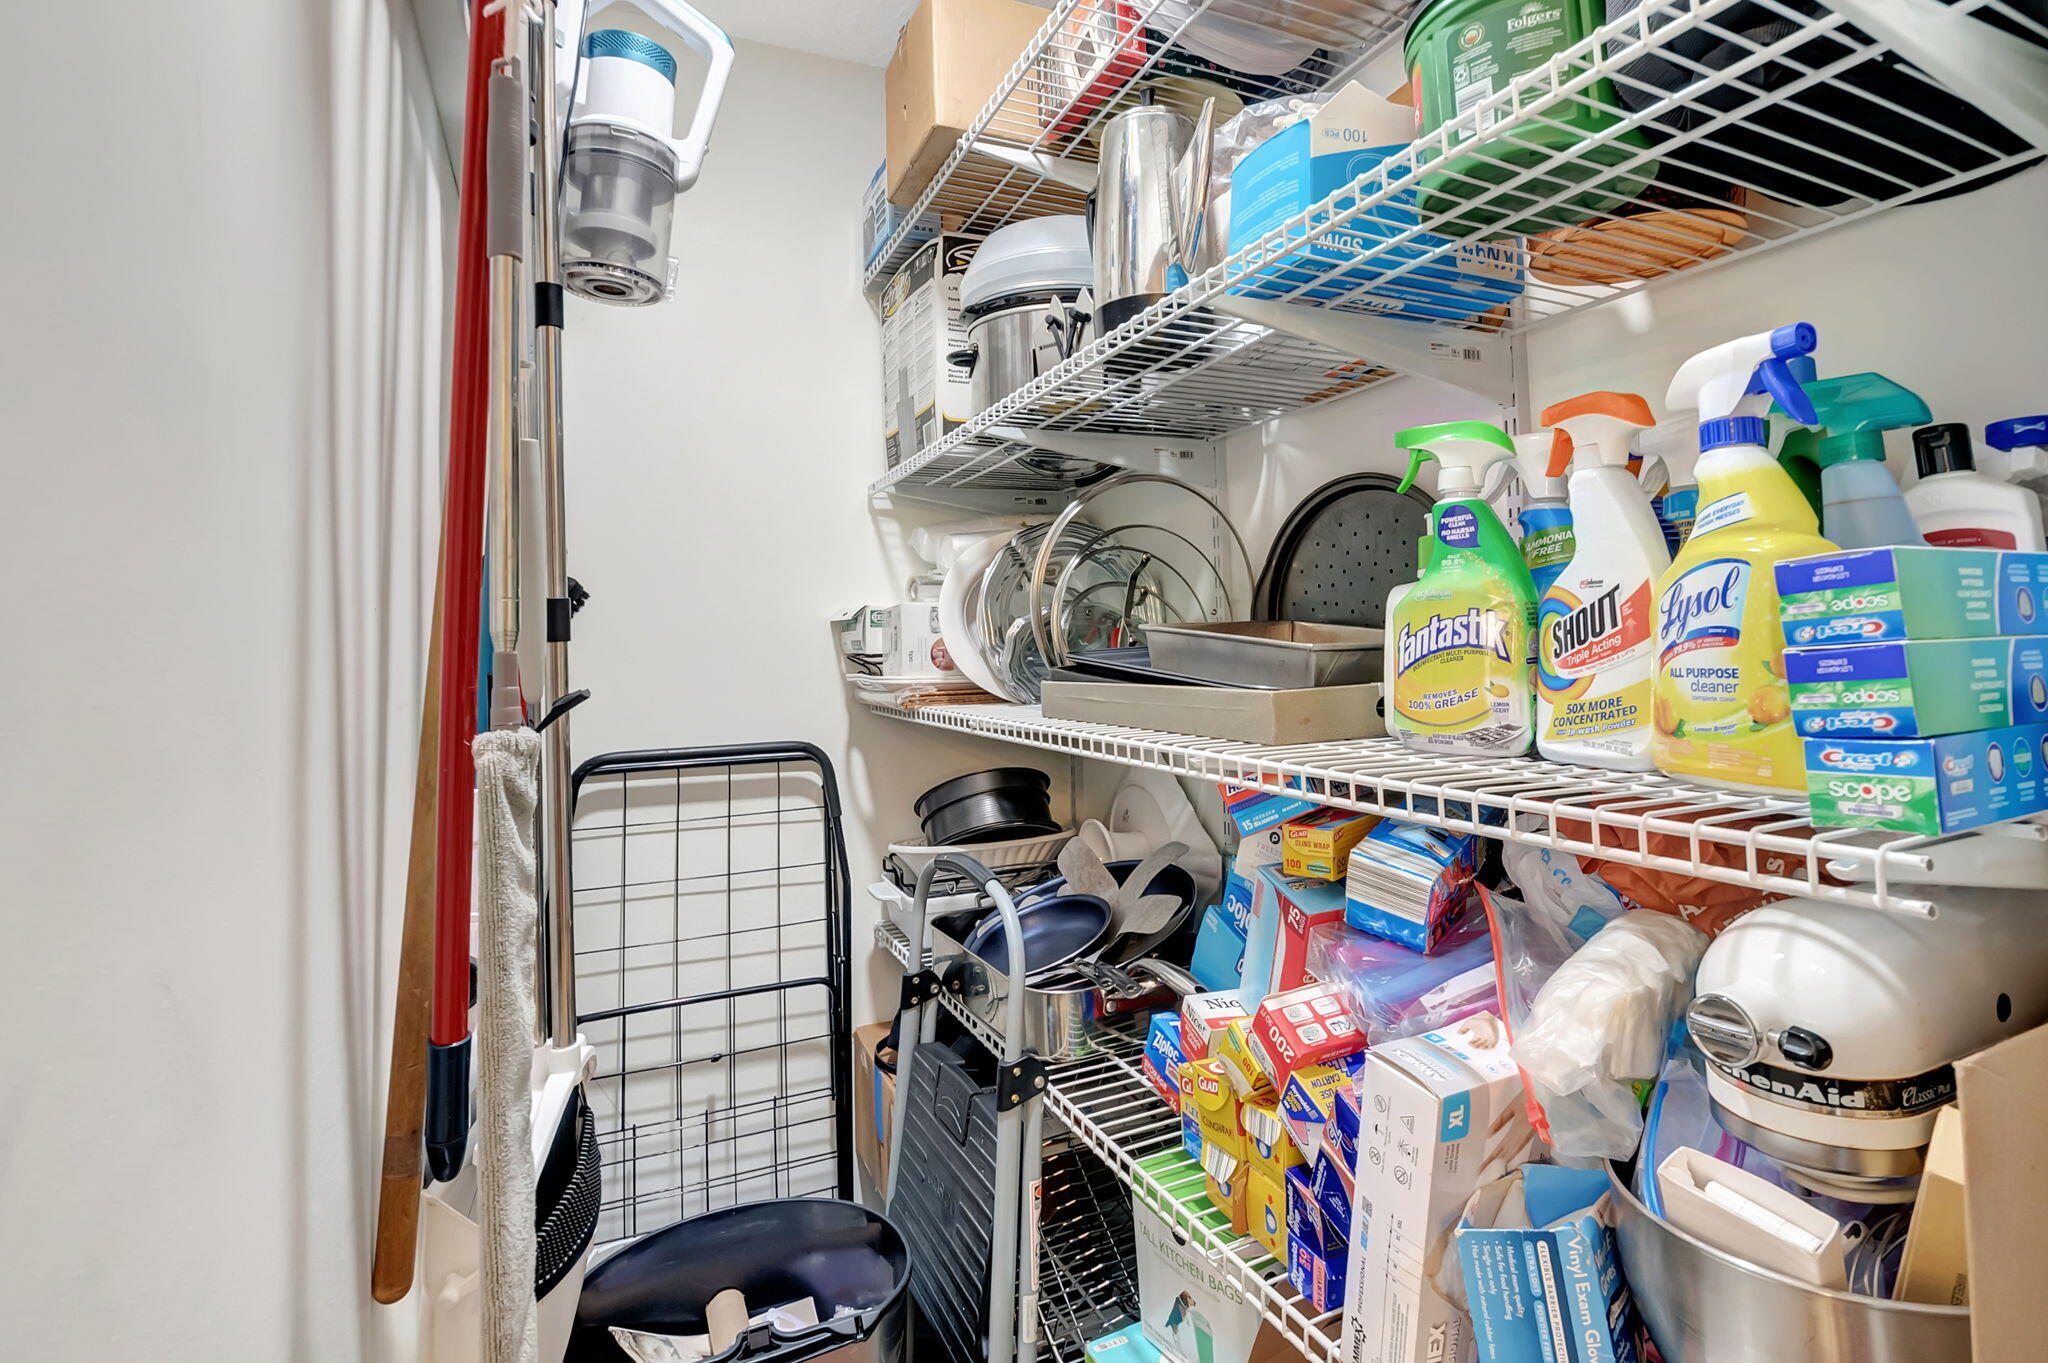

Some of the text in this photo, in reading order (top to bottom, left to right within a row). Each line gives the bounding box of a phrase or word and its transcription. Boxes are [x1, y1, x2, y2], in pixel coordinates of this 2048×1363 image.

[1507, 8, 1562, 33] Folgers
[1343, 128, 1368, 143] 100
[1440, 514, 1474, 525] POWERFUL
[1441, 526, 1475, 537] NO HARSH
[1446, 533, 1470, 541] SMELLS
[1525, 530, 1573, 552] AMMONIA
[1532, 542, 1563, 558] FREE
[1660, 565, 1740, 640] Lysol
[1830, 594, 1889, 611] scope
[1553, 583, 1620, 659] SHOUT
[1816, 620, 1885, 640] Crest
[1398, 608, 1512, 679] fantastik
[1567, 649, 1590, 667] Triple
[1591, 634, 1622, 654] Acting
[1440, 656, 1464, 665] CLEANER
[1670, 667, 1739, 679] ALL PURPOSE
[1423, 688, 1458, 700] REMOVES
[1690, 681, 1739, 693] cleaner
[1841, 688, 1900, 704] scope
[1408, 687, 1479, 711] 100% GREASE
[1566, 696, 1623, 715] 50X MORE
[1553, 705, 1638, 728] CONCENTRATED
[1602, 718, 1637, 732] Powder
[1826, 716, 1896, 732] Crest
[1820, 749, 1894, 765] Crest
[1828, 780, 1913, 805] scope
[1241, 819, 1254, 831] 15
[1290, 830, 1308, 838] GLAD
[1295, 840, 1330, 850] CLING WRAP
[1286, 859, 1302, 869] 100
[1287, 906, 1301, 931] 75
[1152, 1030, 1179, 1062] Ziploc
[1269, 1026, 1295, 1063] 200
[1242, 1058, 1253, 1076] 100
[1182, 1077, 1194, 1094] GL
[1198, 1076, 1218, 1094] GLAD
[1310, 1073, 1341, 1089] CARTON
[1720, 1064, 1867, 1109] henAid
[1319, 1088, 1335, 1100] USE
[1901, 1085, 1936, 1107] Classic
[1448, 1104, 1464, 1129] XL
[1138, 1219, 1243, 1305] TALL KITCHEN BAGS
[1525, 1245, 1535, 1272] ULTRA
[1567, 1237, 1588, 1278] Vinyl
[1474, 1259, 1483, 1280] made
[1482, 1245, 1491, 1266] Single
[1488, 1279, 1498, 1295] only
[1314, 1266, 1322, 1309] EVERYDAY
[1358, 1256, 1367, 1316] PROFESSIONAL
[1478, 1279, 1486, 1294] with
[1495, 1245, 1513, 1320] Safe for food handling
[1506, 1245, 1525, 1319] Medical exam quality
[1540, 1245, 1551, 1282] FLEXIBLE
[1547, 1285, 1558, 1319] BARRIER
[1481, 1295, 1491, 1320] natural
[1576, 1282, 1592, 1326] Exam
[1484, 1320, 1494, 1343] rubber
[1536, 1305, 1553, 1362] POWDER FREE
